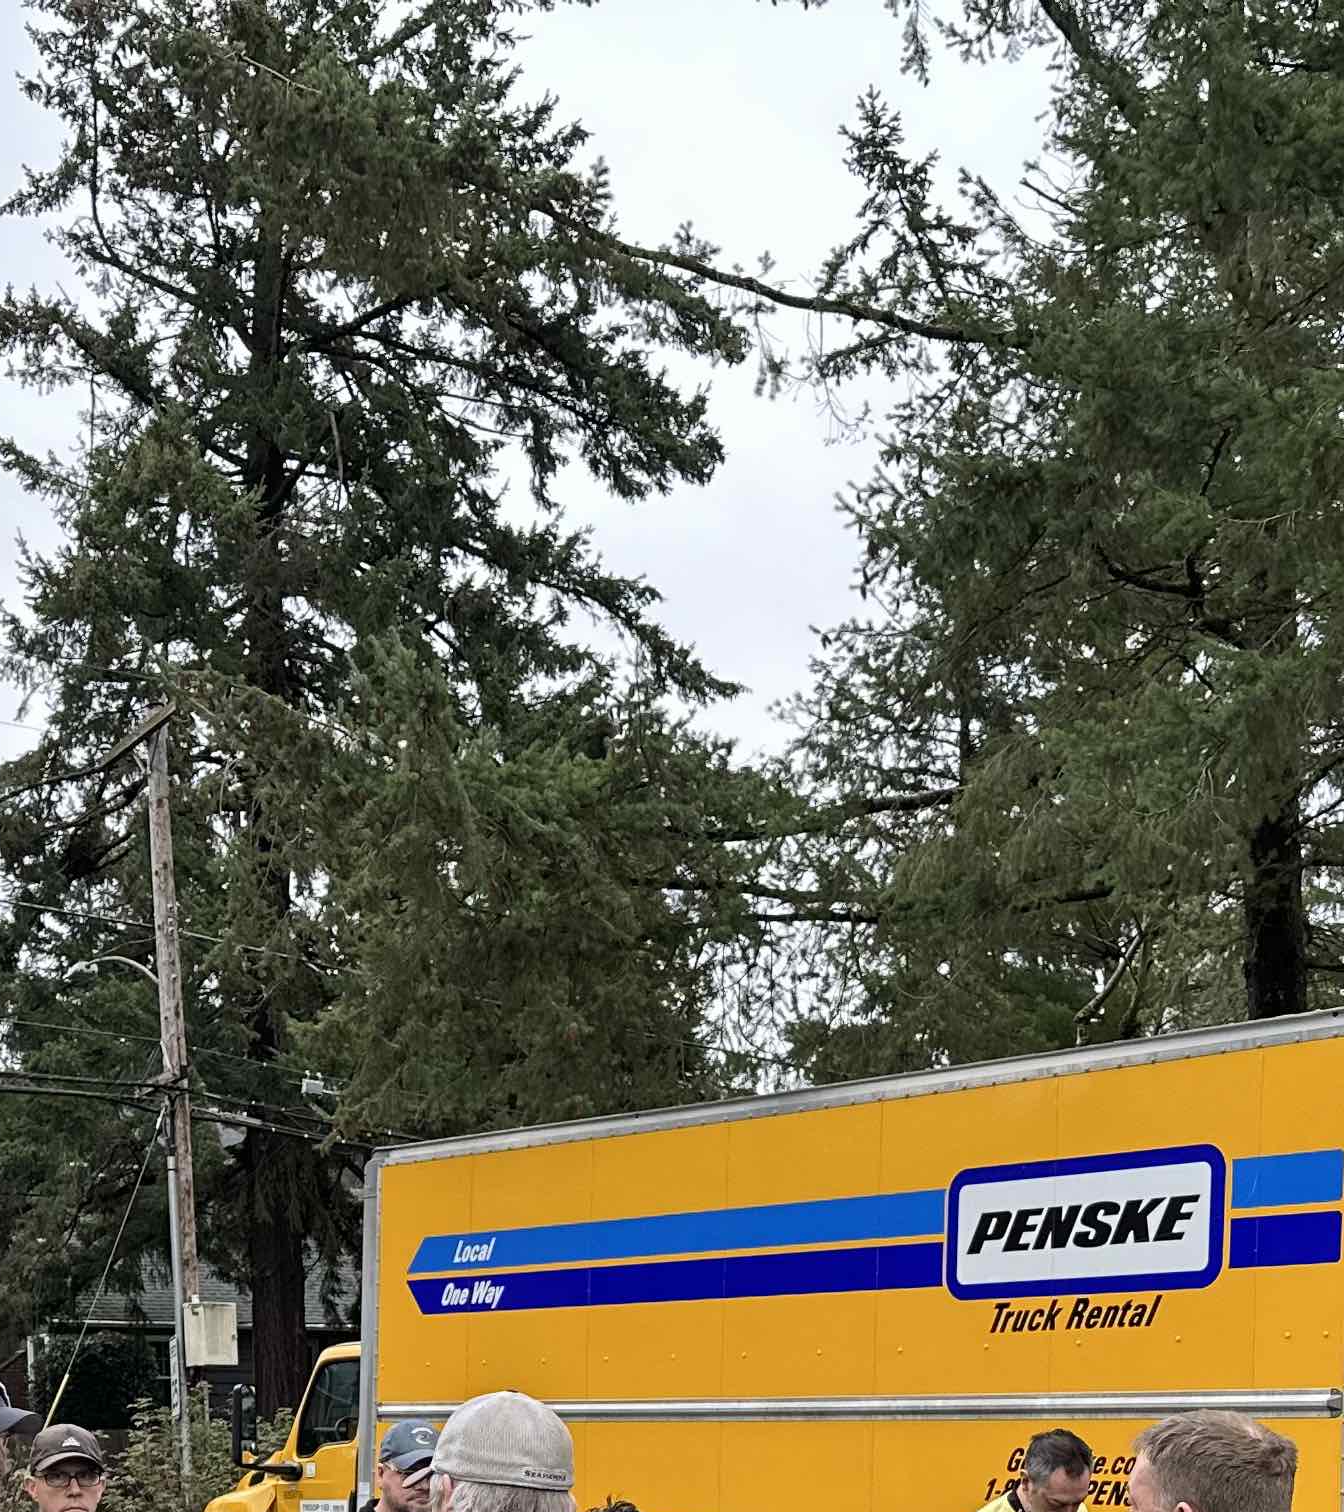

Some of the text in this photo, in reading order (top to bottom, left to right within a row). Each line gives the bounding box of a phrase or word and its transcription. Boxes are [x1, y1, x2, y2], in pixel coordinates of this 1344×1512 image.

[966, 1194, 1201, 1255] PENSKE
[453, 1237, 497, 1263] Local
[441, 1280, 505, 1309] One Way
[989, 1294, 1163, 1334] Truck Rental
